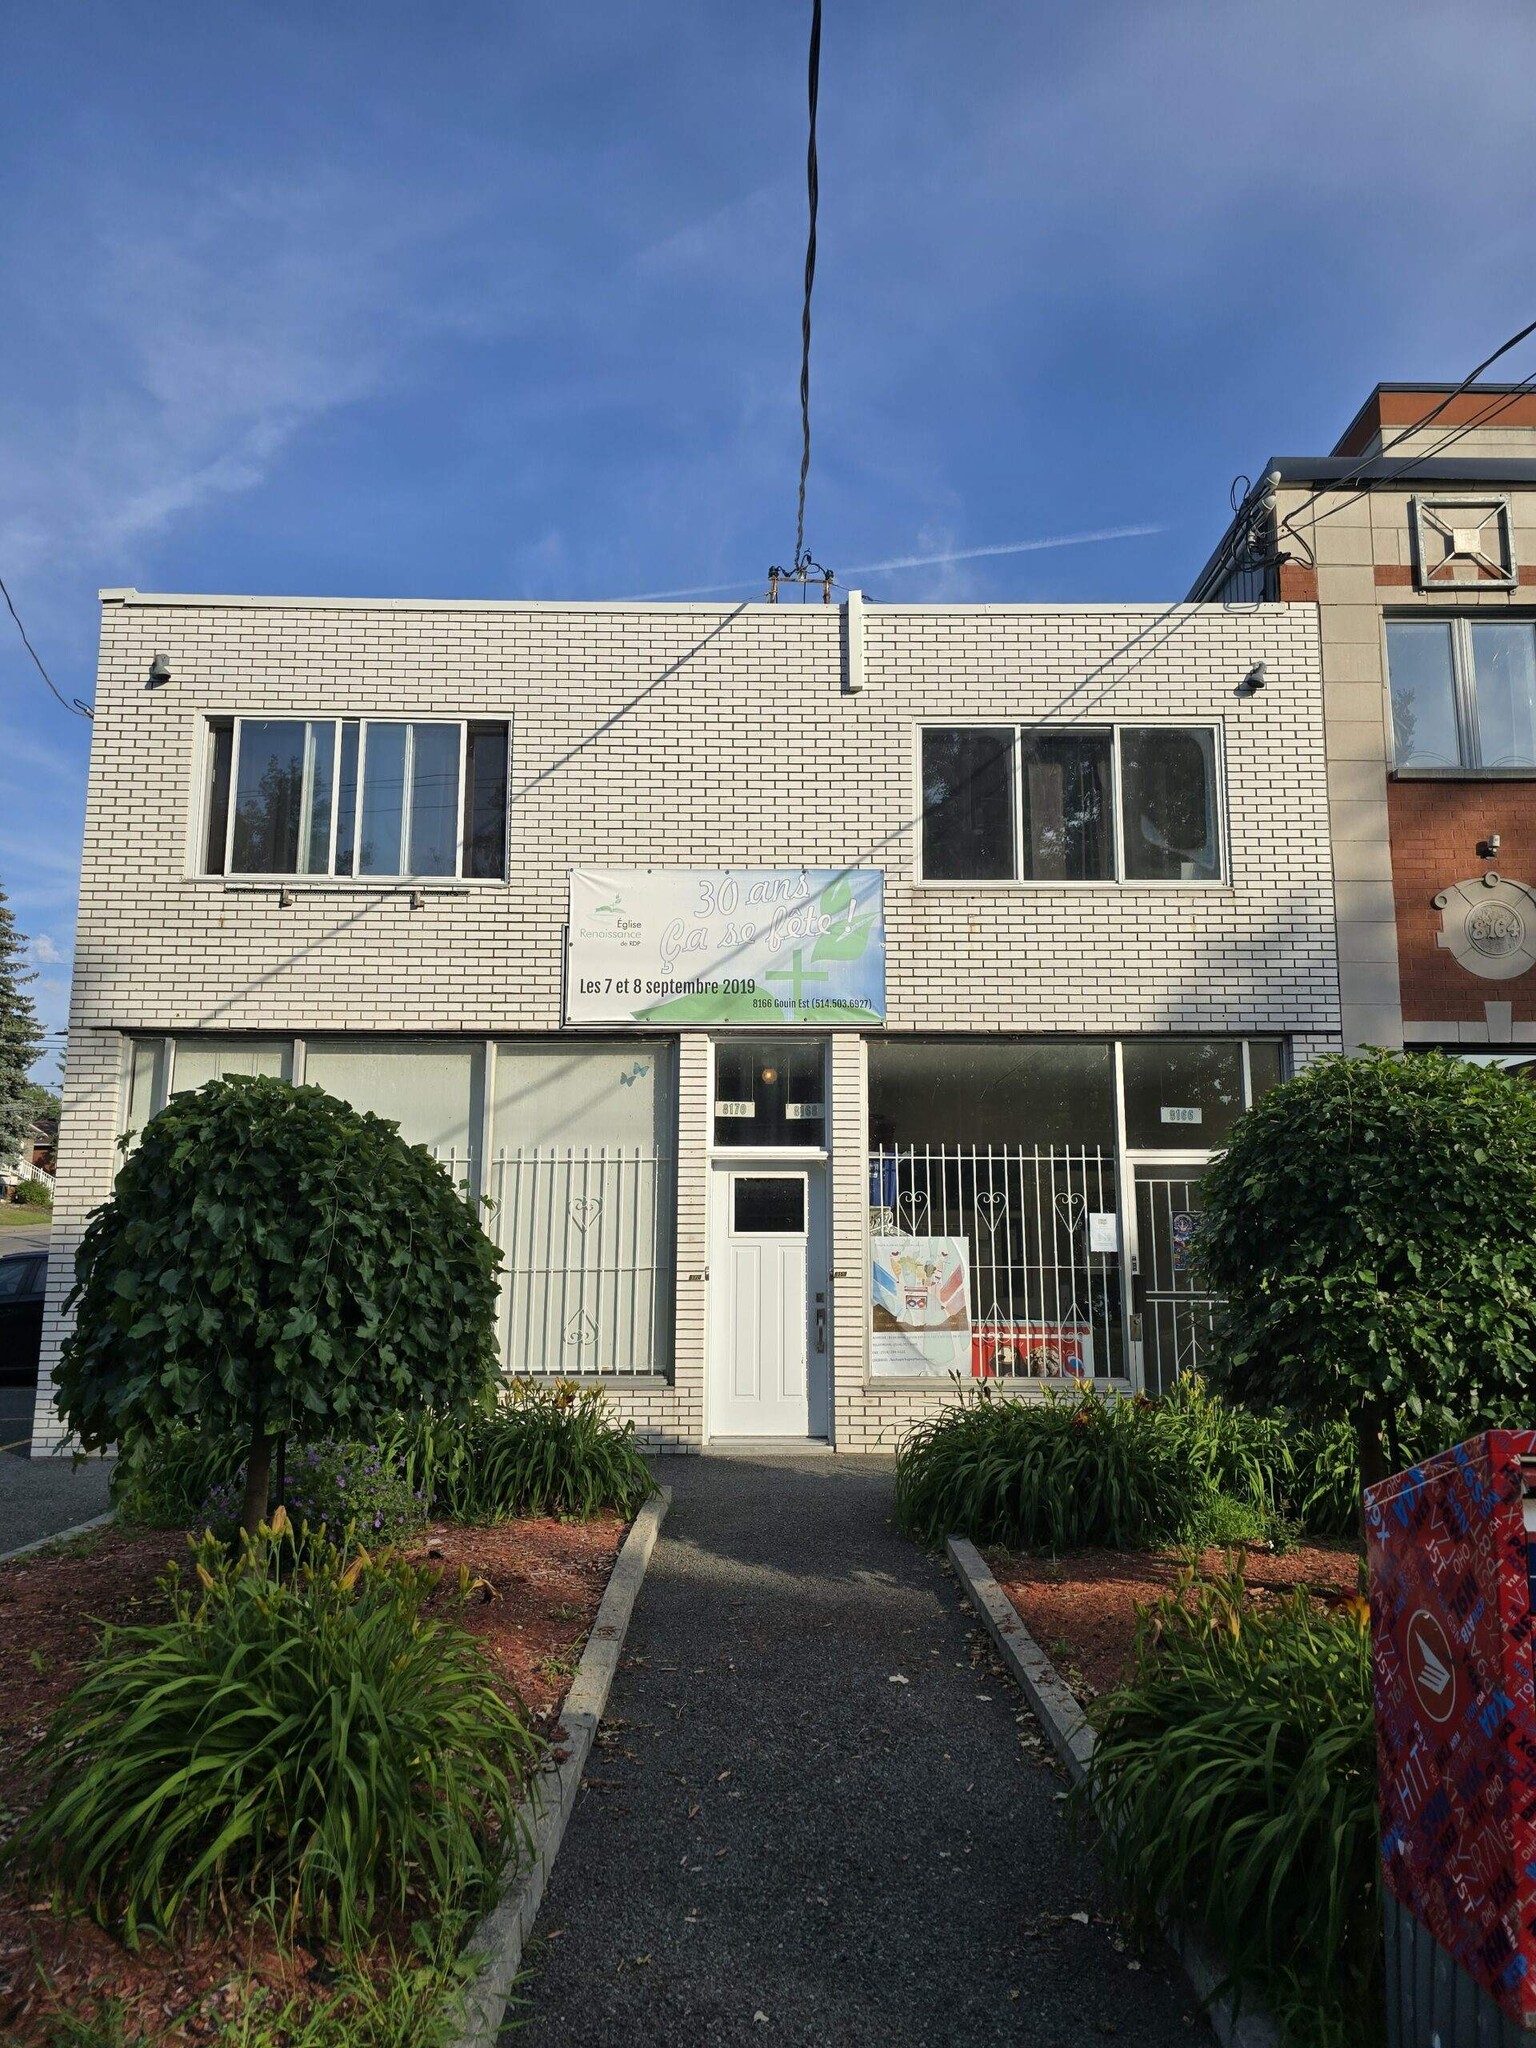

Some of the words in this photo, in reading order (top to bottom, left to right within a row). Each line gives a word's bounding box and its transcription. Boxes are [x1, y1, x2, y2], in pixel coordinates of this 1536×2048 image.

[694, 877, 739, 918] 30
[745, 874, 811, 905] ans
[617, 917, 642, 930] Église
[580, 928, 642, 939] Renaissance
[660, 918, 708, 974] Ça
[717, 922, 756, 948] se
[765, 906, 832, 952] fête
[580, 978, 601, 995] Les
[604, 979, 613, 994] 7
[616, 979, 630, 994] et
[633, 979, 642, 994] 8
[645, 978, 719, 998] septembre
[722, 979, 756, 995] 2019
[752, 998, 773, 1009] 8166
[774, 998, 797, 1009] Gouin
[798, 998, 810, 1009] Est
[811, 998, 872, 1010] (514.503.6927)
